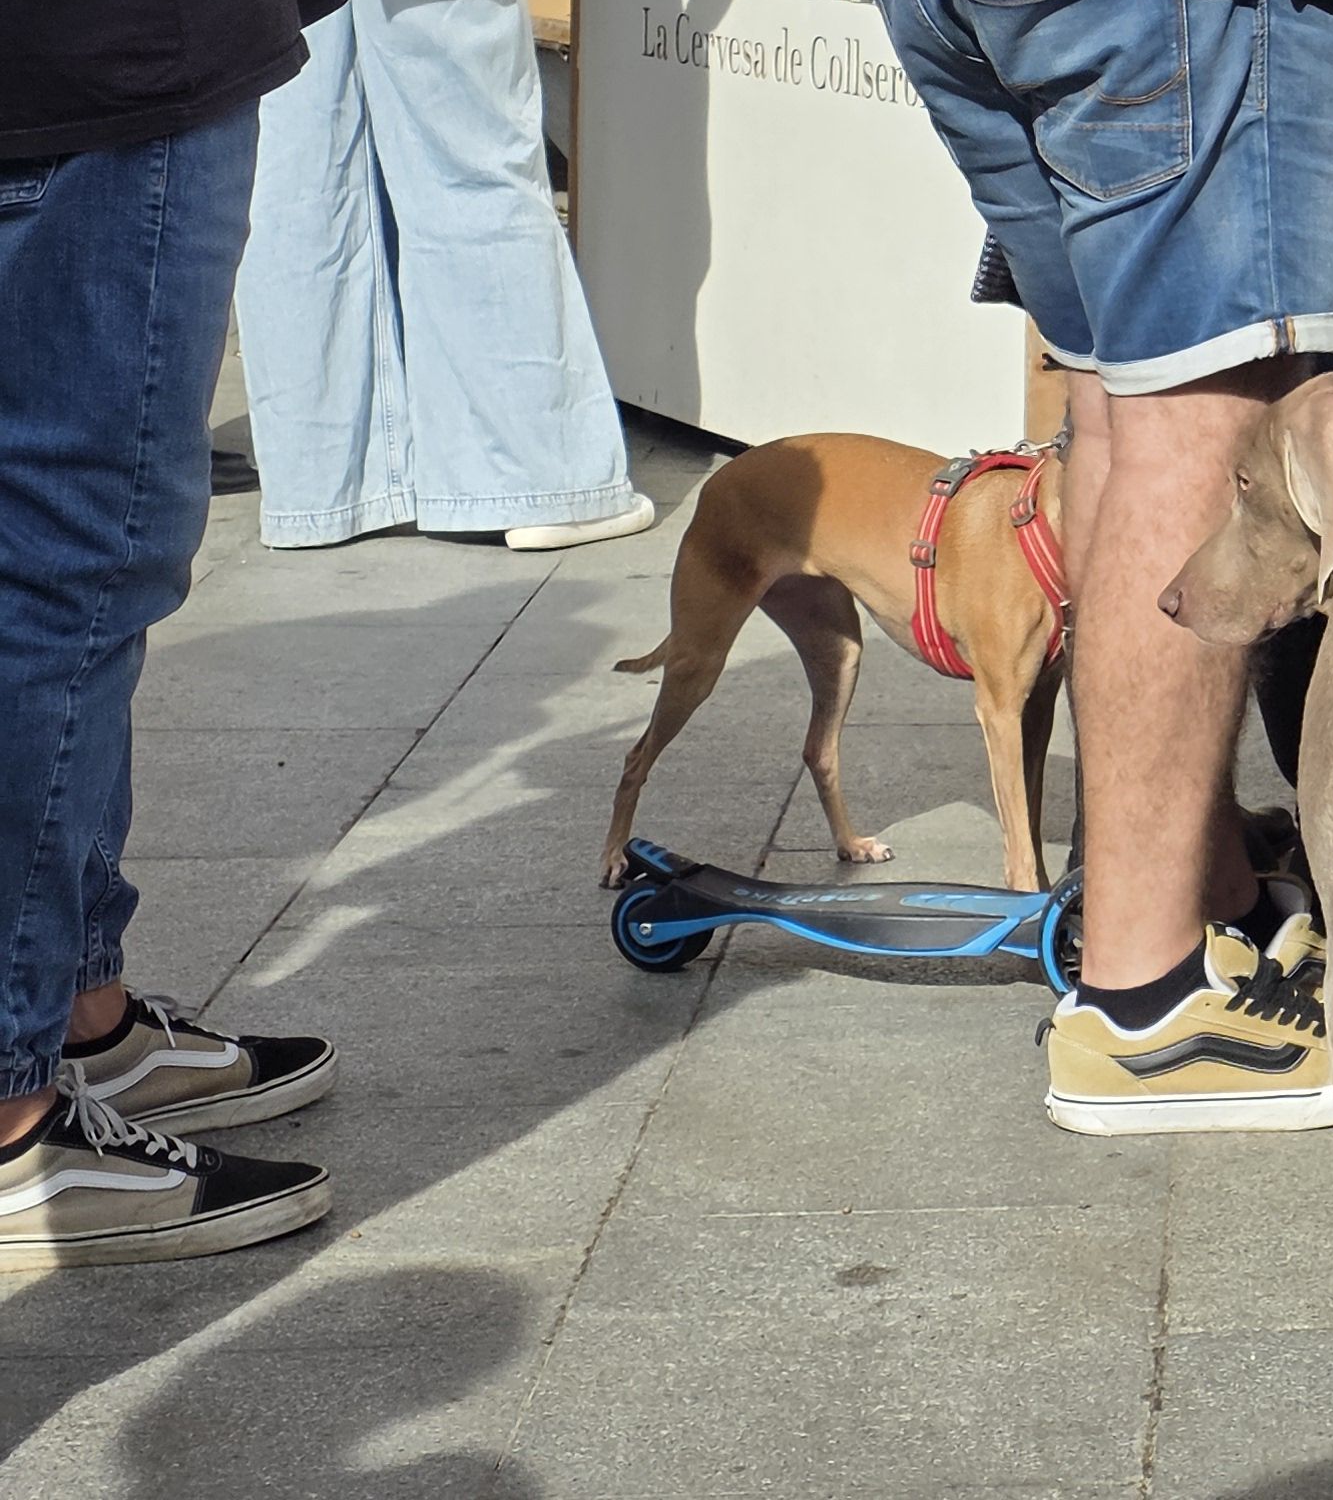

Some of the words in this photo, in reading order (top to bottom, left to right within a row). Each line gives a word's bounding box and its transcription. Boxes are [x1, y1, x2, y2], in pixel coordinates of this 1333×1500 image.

[641, 7, 668, 61] La
[675, 12, 768, 83] Cervesa
[774, 27, 803, 86] de
